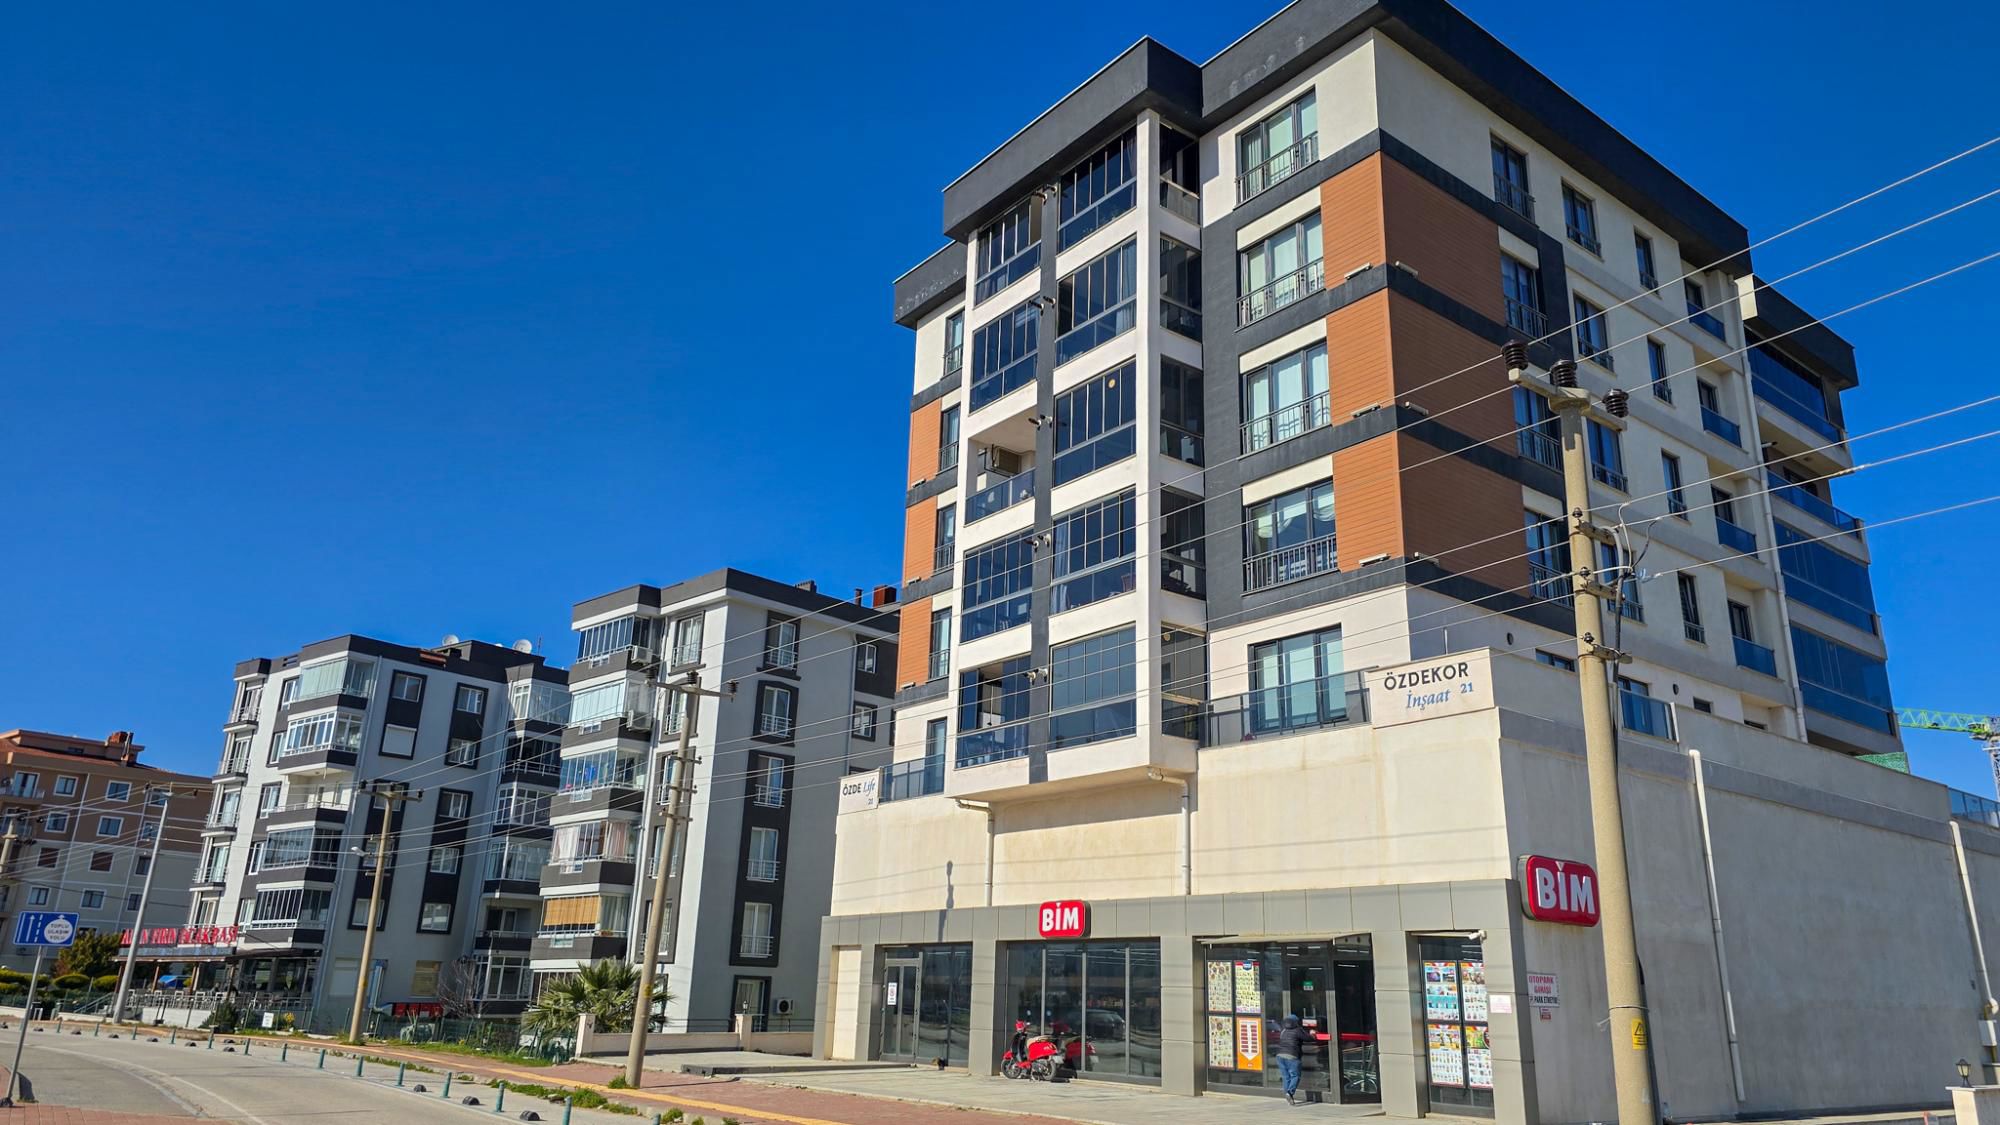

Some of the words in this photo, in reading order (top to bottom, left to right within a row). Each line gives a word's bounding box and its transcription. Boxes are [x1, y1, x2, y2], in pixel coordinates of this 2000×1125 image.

[1384, 662, 1469, 690] ÖZDEKOR
[1407, 689, 1451, 710] İnşaat
[1460, 682, 1473, 694] 21
[842, 783, 861, 796] ÖZDE
[1536, 861, 1596, 915] BİM
[1042, 902, 1079, 932] BİM
